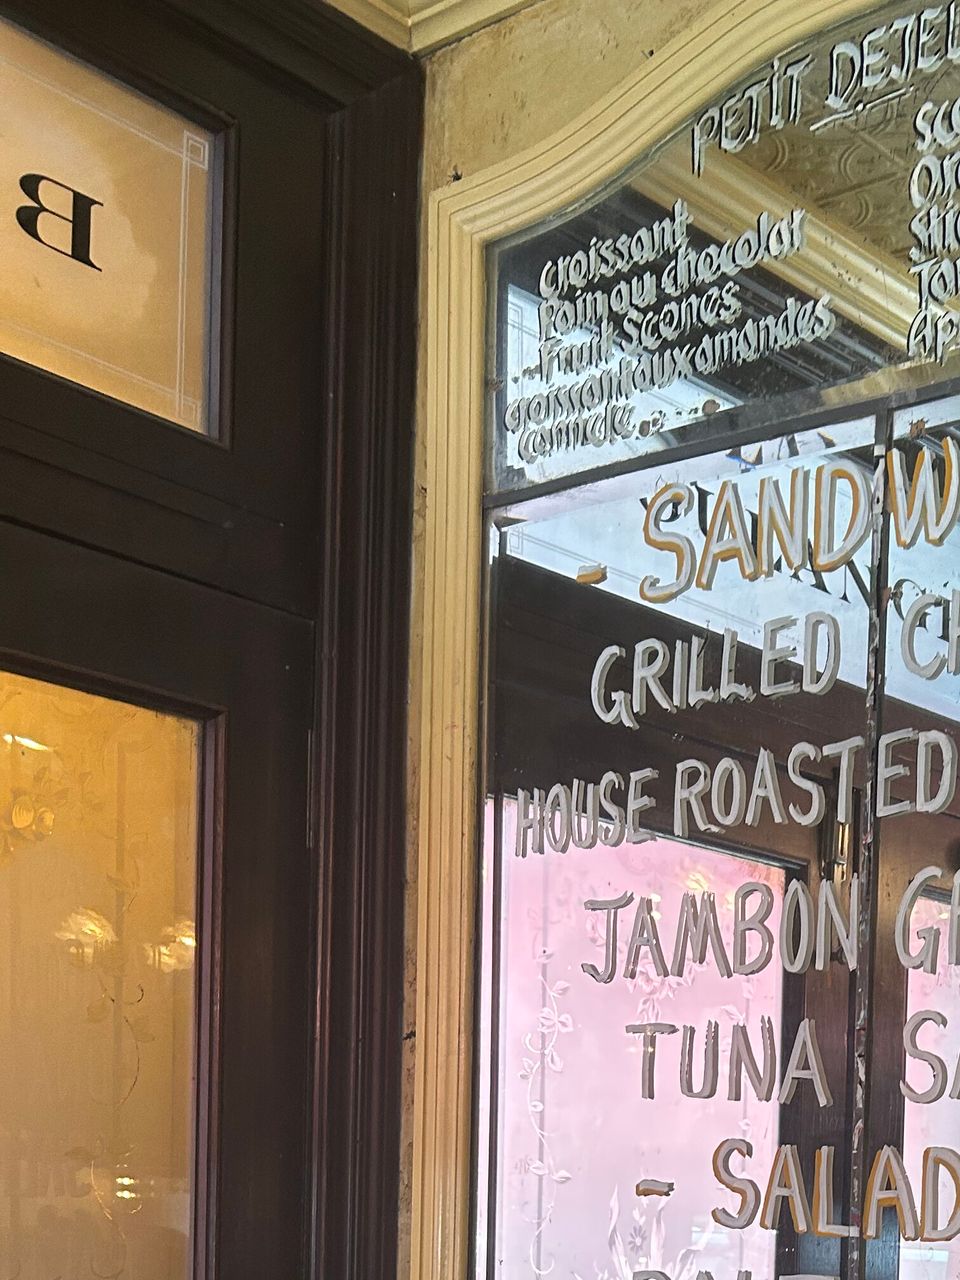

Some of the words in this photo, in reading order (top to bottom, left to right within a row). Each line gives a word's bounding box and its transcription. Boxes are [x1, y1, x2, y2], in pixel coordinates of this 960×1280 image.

[539, 199, 693, 299] croissant
[539, 288, 608, 341] Pain
[611, 272, 657, 314] au
[662, 208, 808, 297] chocolat
[505, 356, 633, 433] croissant
[633, 345, 694, 396] aux
[694, 293, 836, 374] amandes
[539, 318, 621, 383] Fruit
[590, 612, 840, 730] GRILLED
[515, 766, 659, 858] HOUSE
[673, 727, 958, 837] ROASTED
[581, 873, 860, 985] JAMBON
[626, 1014, 832, 1108] TUNA
